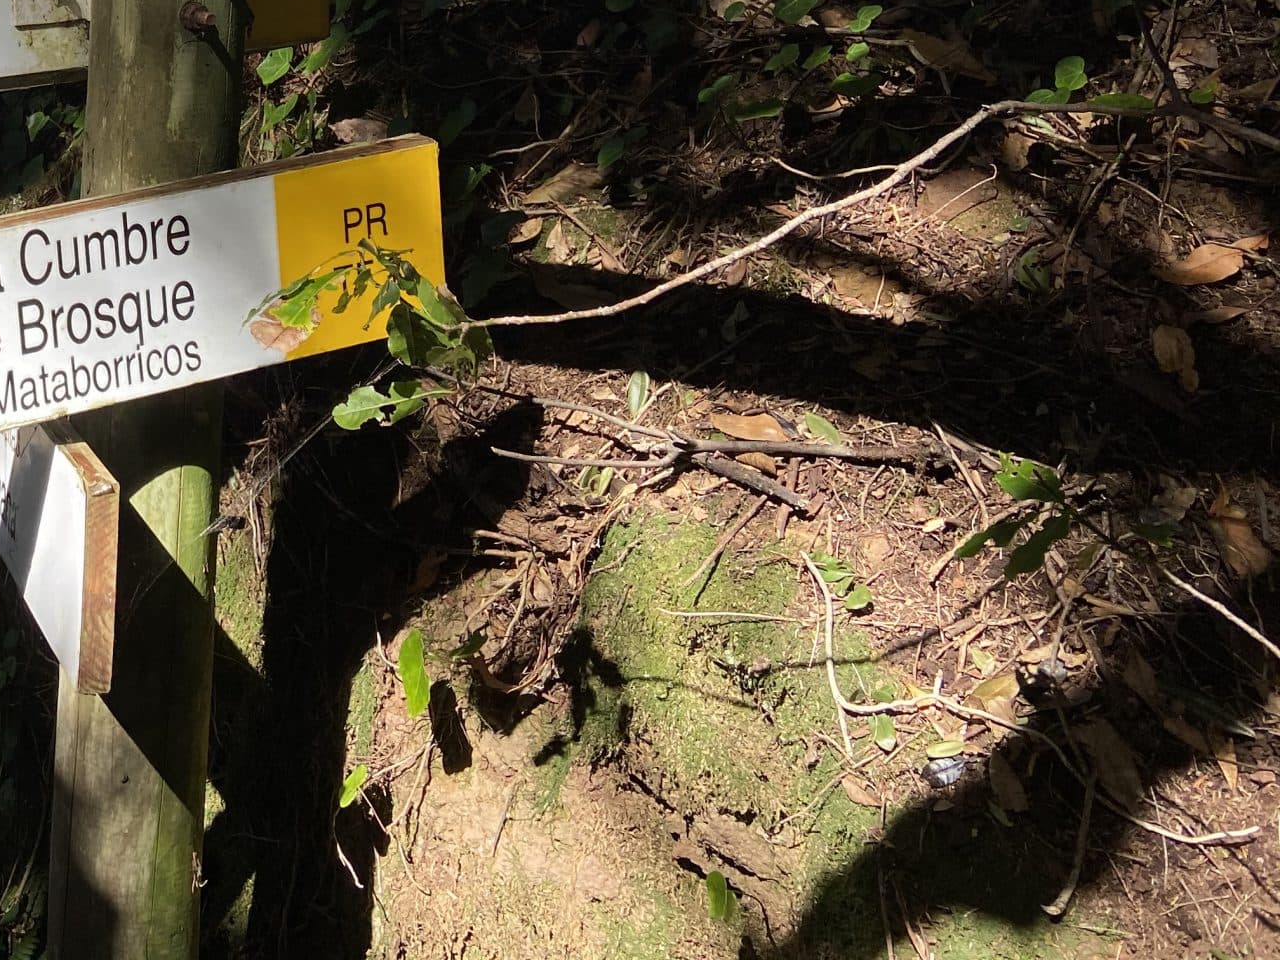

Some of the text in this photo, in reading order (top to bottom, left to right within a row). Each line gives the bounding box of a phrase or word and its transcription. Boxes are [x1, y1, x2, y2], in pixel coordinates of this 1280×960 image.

[20, 211, 191, 286] Cumbre
[343, 202, 388, 244] PR
[17, 279, 196, 356] Brosque
